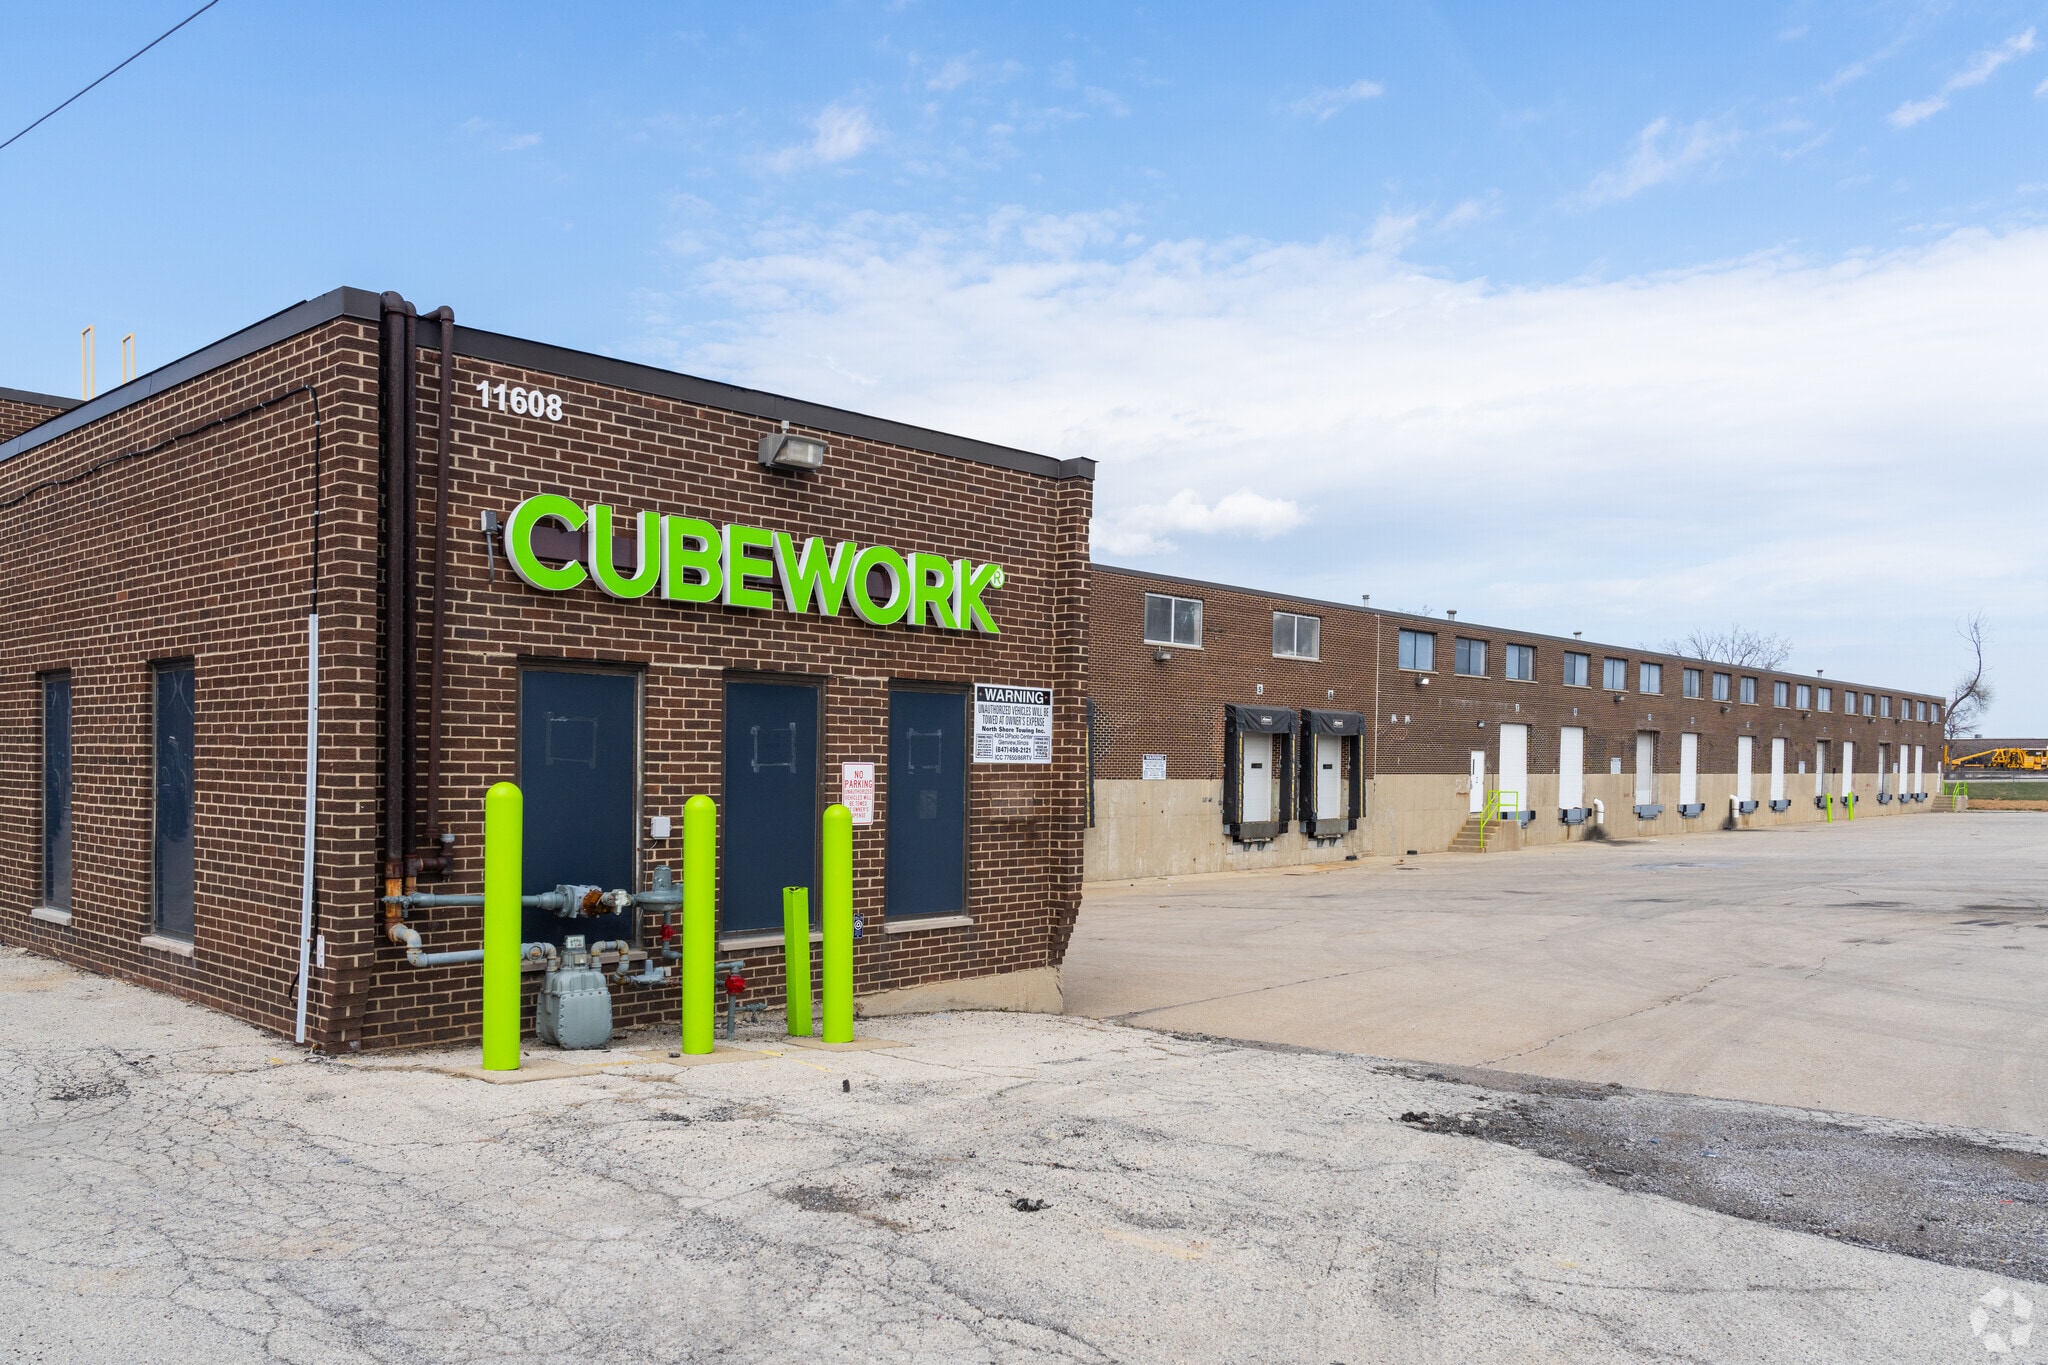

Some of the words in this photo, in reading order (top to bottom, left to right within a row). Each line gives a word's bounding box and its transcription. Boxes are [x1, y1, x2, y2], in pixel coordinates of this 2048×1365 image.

[476, 380, 563, 421] 11608
[984, 688, 1044, 704] WARNING
[978, 704, 1011, 715] UNAUTHORIZED
[1012, 706, 1031, 716] VEHICLES
[1032, 707, 1043, 717] WILL
[1043, 708, 1049, 717] BE
[982, 714, 998, 725] TOWED
[999, 716, 1005, 725] AT
[1005, 716, 1026, 726] OWNER'S
[1026, 717, 1045, 727] EXPENSE
[854, 770, 864, 779] NO
[844, 780, 873, 788] PARKING
